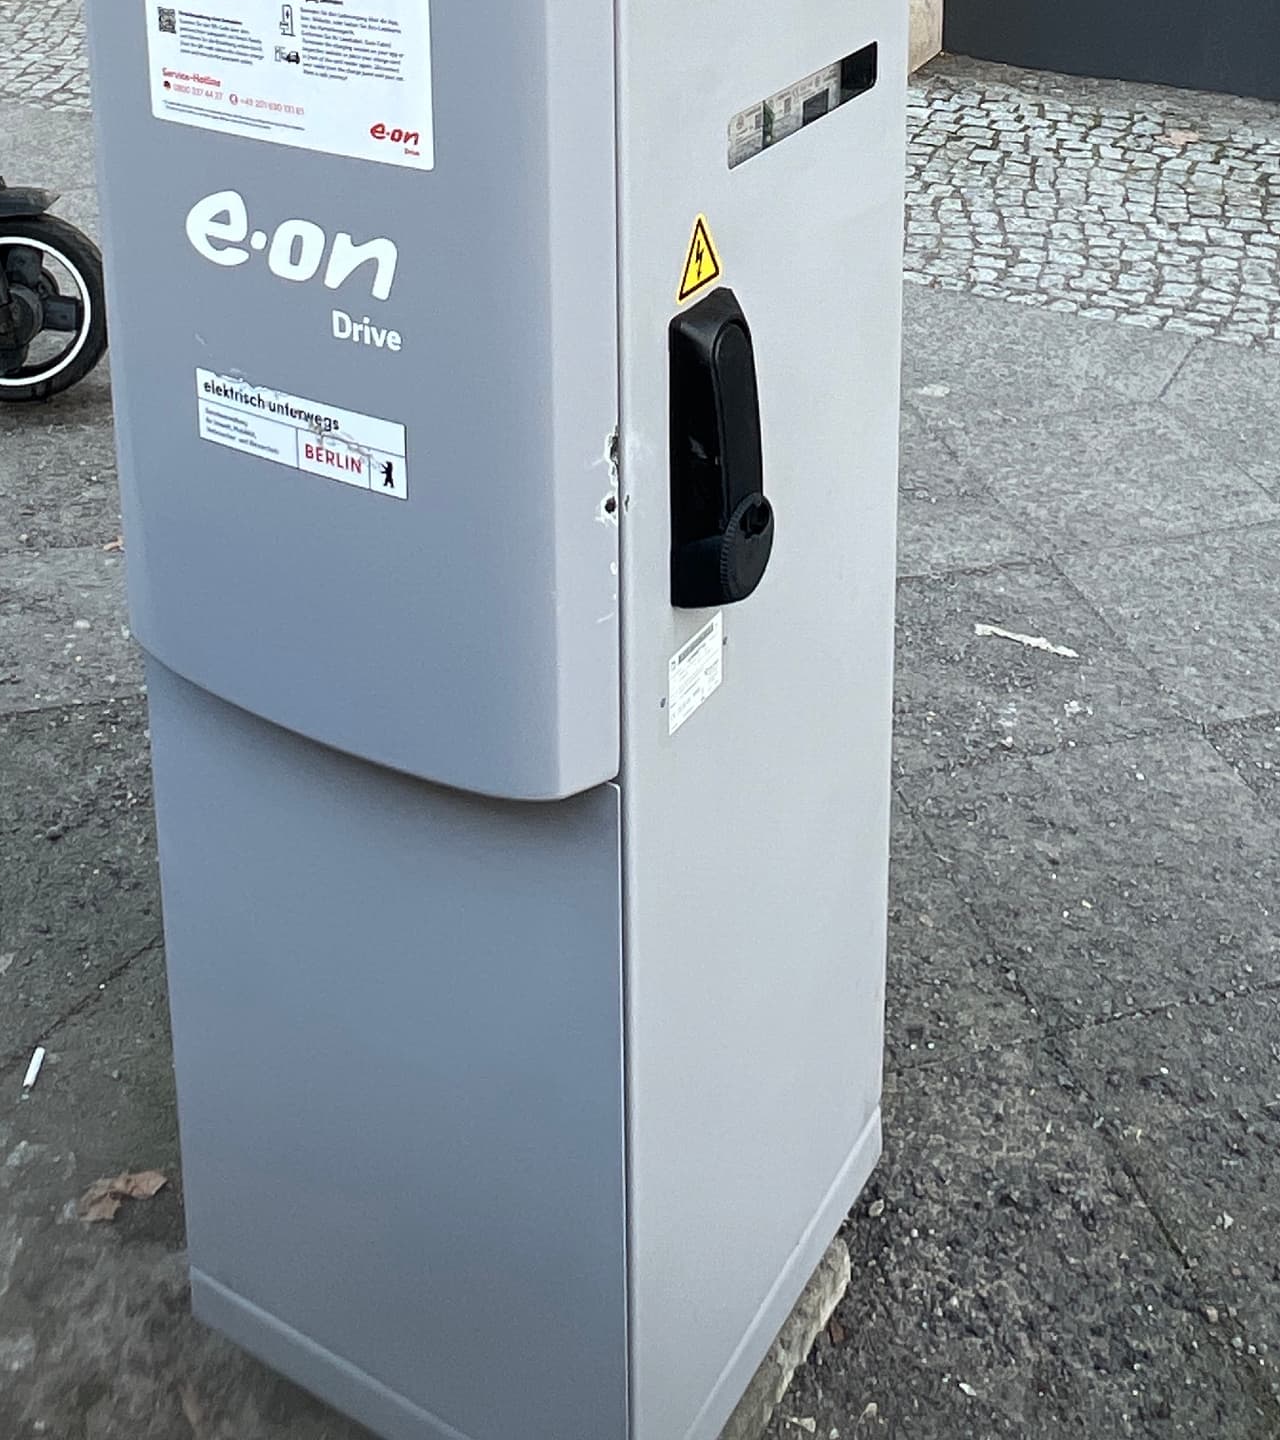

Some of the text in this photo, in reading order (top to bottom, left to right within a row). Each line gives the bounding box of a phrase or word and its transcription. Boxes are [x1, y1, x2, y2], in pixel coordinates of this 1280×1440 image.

[331, 309, 403, 352] Drive
[203, 380, 265, 410] elektrisch
[268, 400, 340, 432] unterwegs
[304, 443, 363, 475] BERLIN
